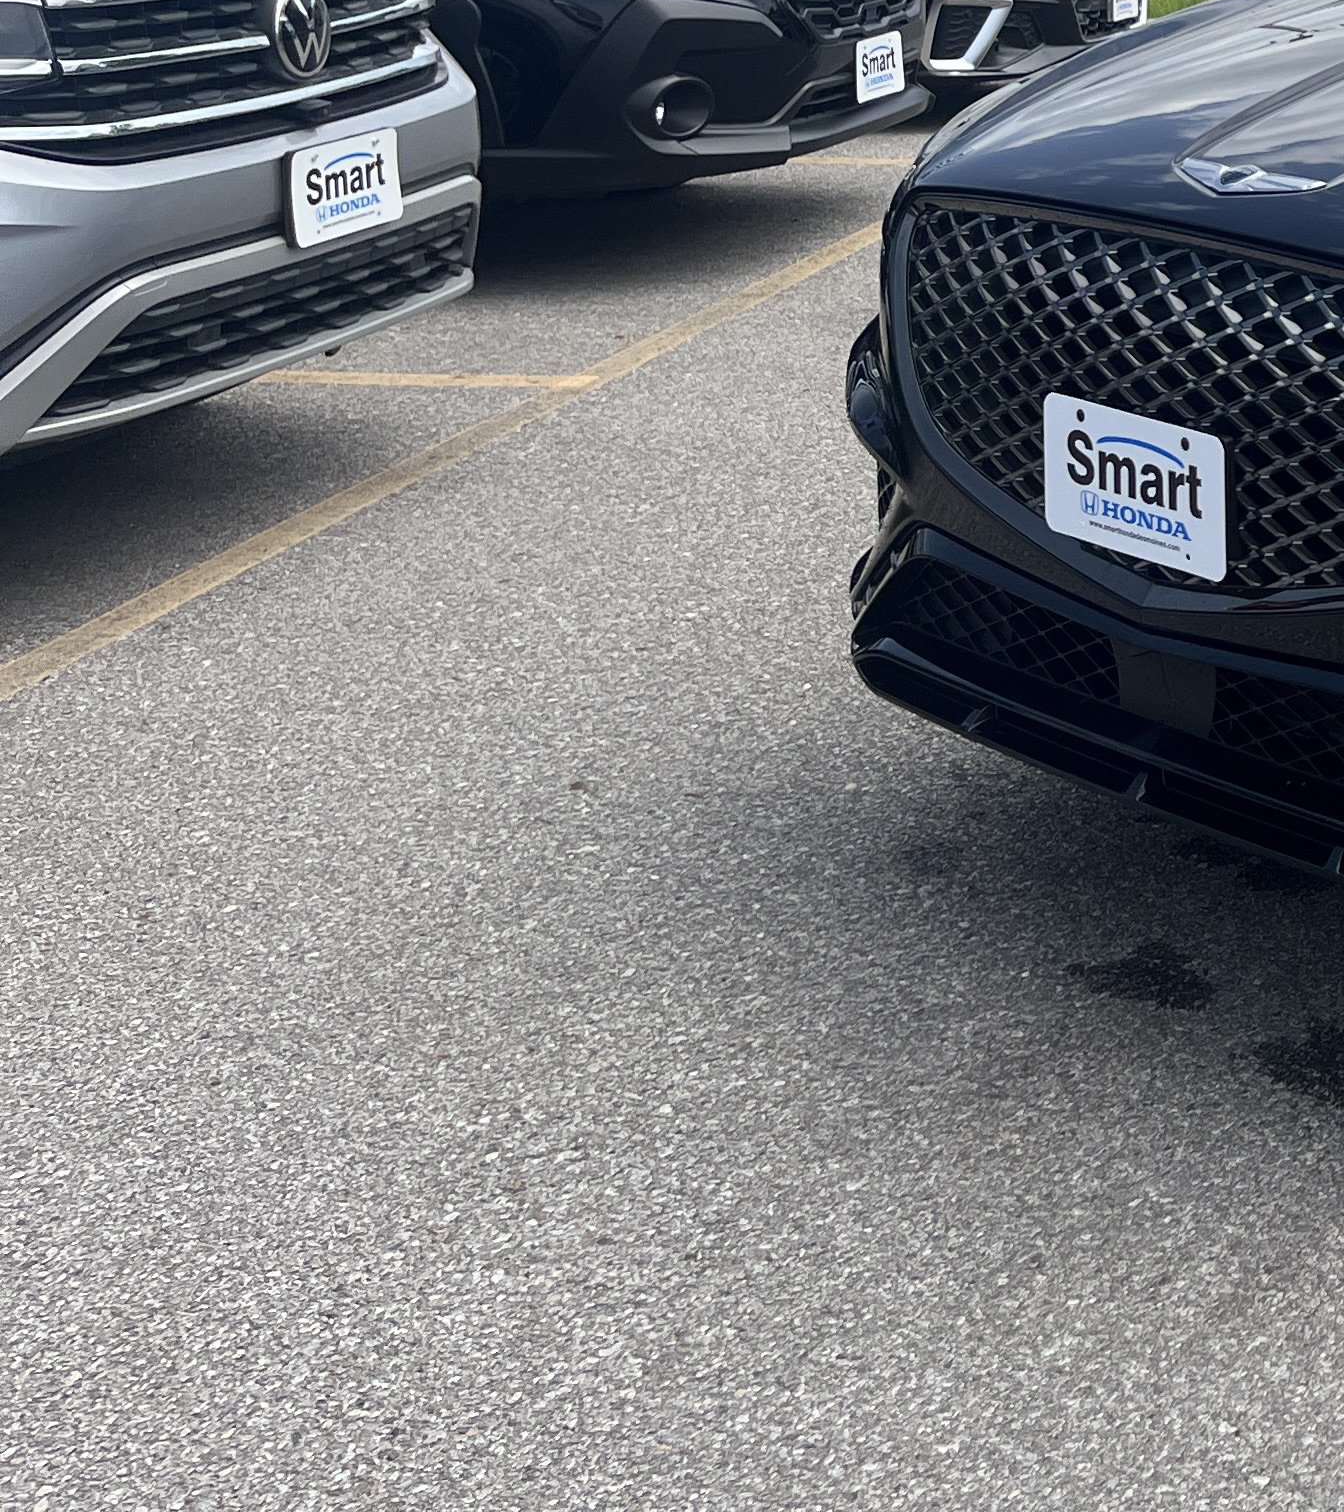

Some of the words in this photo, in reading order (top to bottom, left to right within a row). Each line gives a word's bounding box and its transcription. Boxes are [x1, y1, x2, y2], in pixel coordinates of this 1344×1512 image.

[862, 47, 896, 77] Smart
[306, 153, 386, 206] Smart
[329, 193, 382, 217] HONDA
[1066, 429, 1203, 520] Smart
[1101, 498, 1192, 542] HONDA
